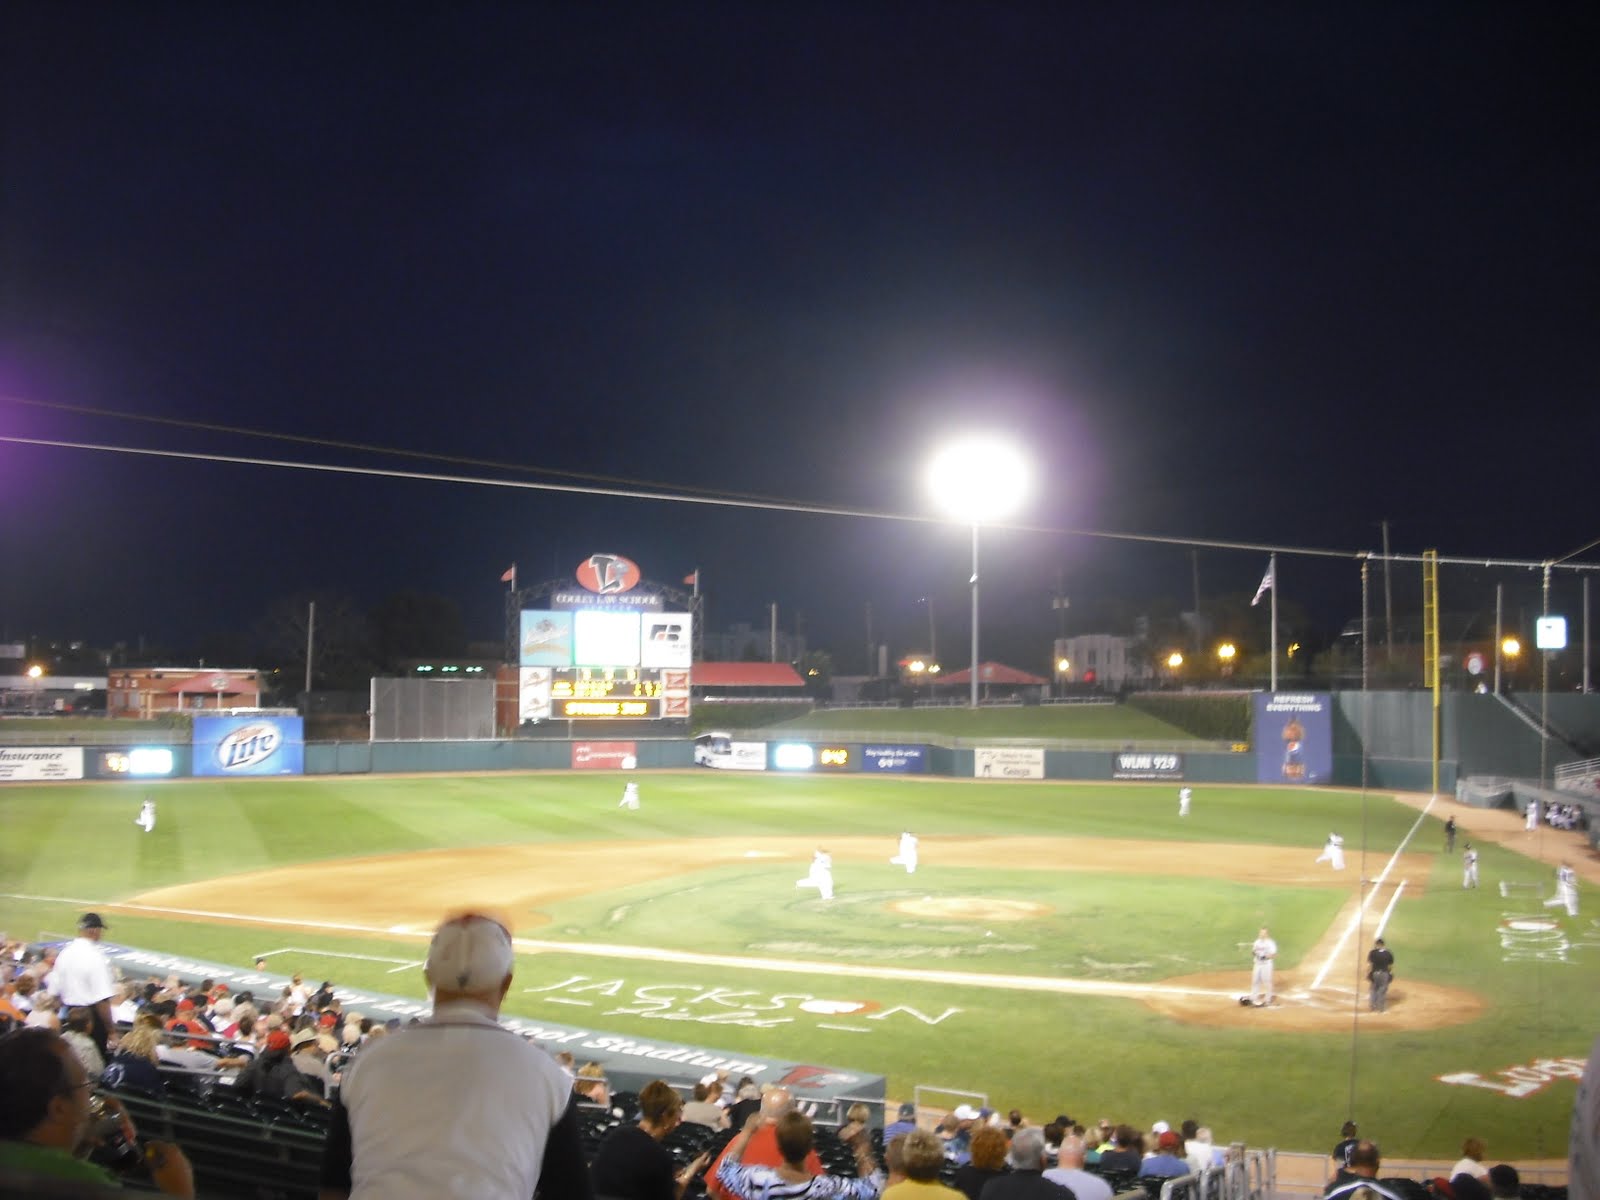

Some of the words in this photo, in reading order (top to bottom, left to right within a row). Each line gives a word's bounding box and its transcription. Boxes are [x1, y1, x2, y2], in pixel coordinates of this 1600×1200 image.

[1266, 703, 1321, 712] EVERYTHING
[1273, 694, 1315, 703] REFRESH
[226, 734, 273, 768] Lite
[523, 974, 964, 1025] JACKSON
[581, 1036, 769, 1076] Stadium
